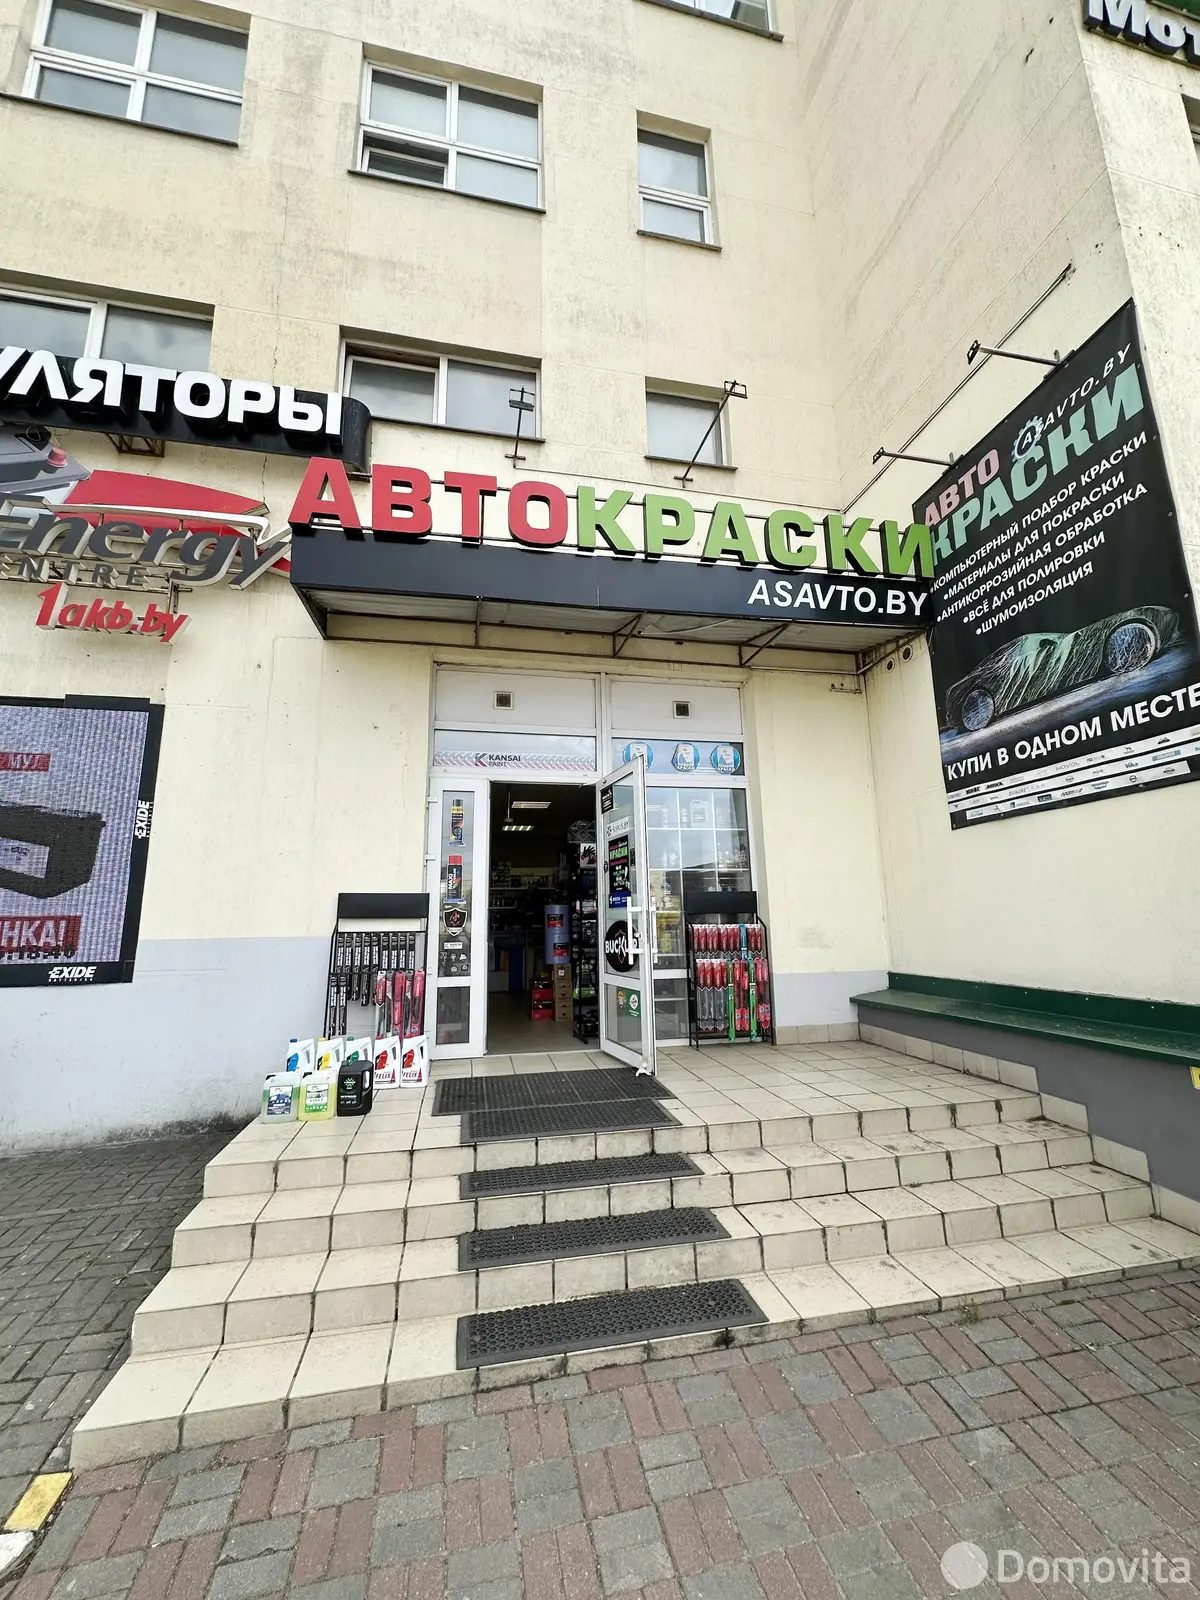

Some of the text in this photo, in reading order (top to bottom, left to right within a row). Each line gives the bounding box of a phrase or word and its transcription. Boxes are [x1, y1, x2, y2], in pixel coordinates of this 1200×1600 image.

[925, 448, 1000, 526] АВТО
[929, 362, 1145, 567] КРАСКИ
[288, 457, 934, 578] АВТОКРАСКИ
[933, 430, 1147, 592] КОМПЬЮТЕРНЫЙ ПОДБОР КРАСКИ
[948, 471, 1125, 599] МАТЕРИАЛЫ ДЛЯ ПОКРАСКИ
[0, 556, 151, 590] NTRE
[941, 483, 1148, 621] АНТИКОРРОЗИЙНАЯ ОБРАБОТКА
[968, 531, 1106, 623] ВСЁ ДЛЯ ПОЛИРОВКИ
[36, 582, 190, 645] 1akb.by
[747, 578, 928, 617] ASAVTO.BY
[981, 561, 1094, 635] ШУМОИЗОЛЯЦИЯ
[488, 754, 521, 762] KANSAI
[947, 682, 1200, 781] КУПИ В ОДНОМ МЕСТЕ
[135, 800, 150, 839] EXIDE
[48, 966, 97, 979] EXIDE
[605, 935, 638, 958] BUCKLR
